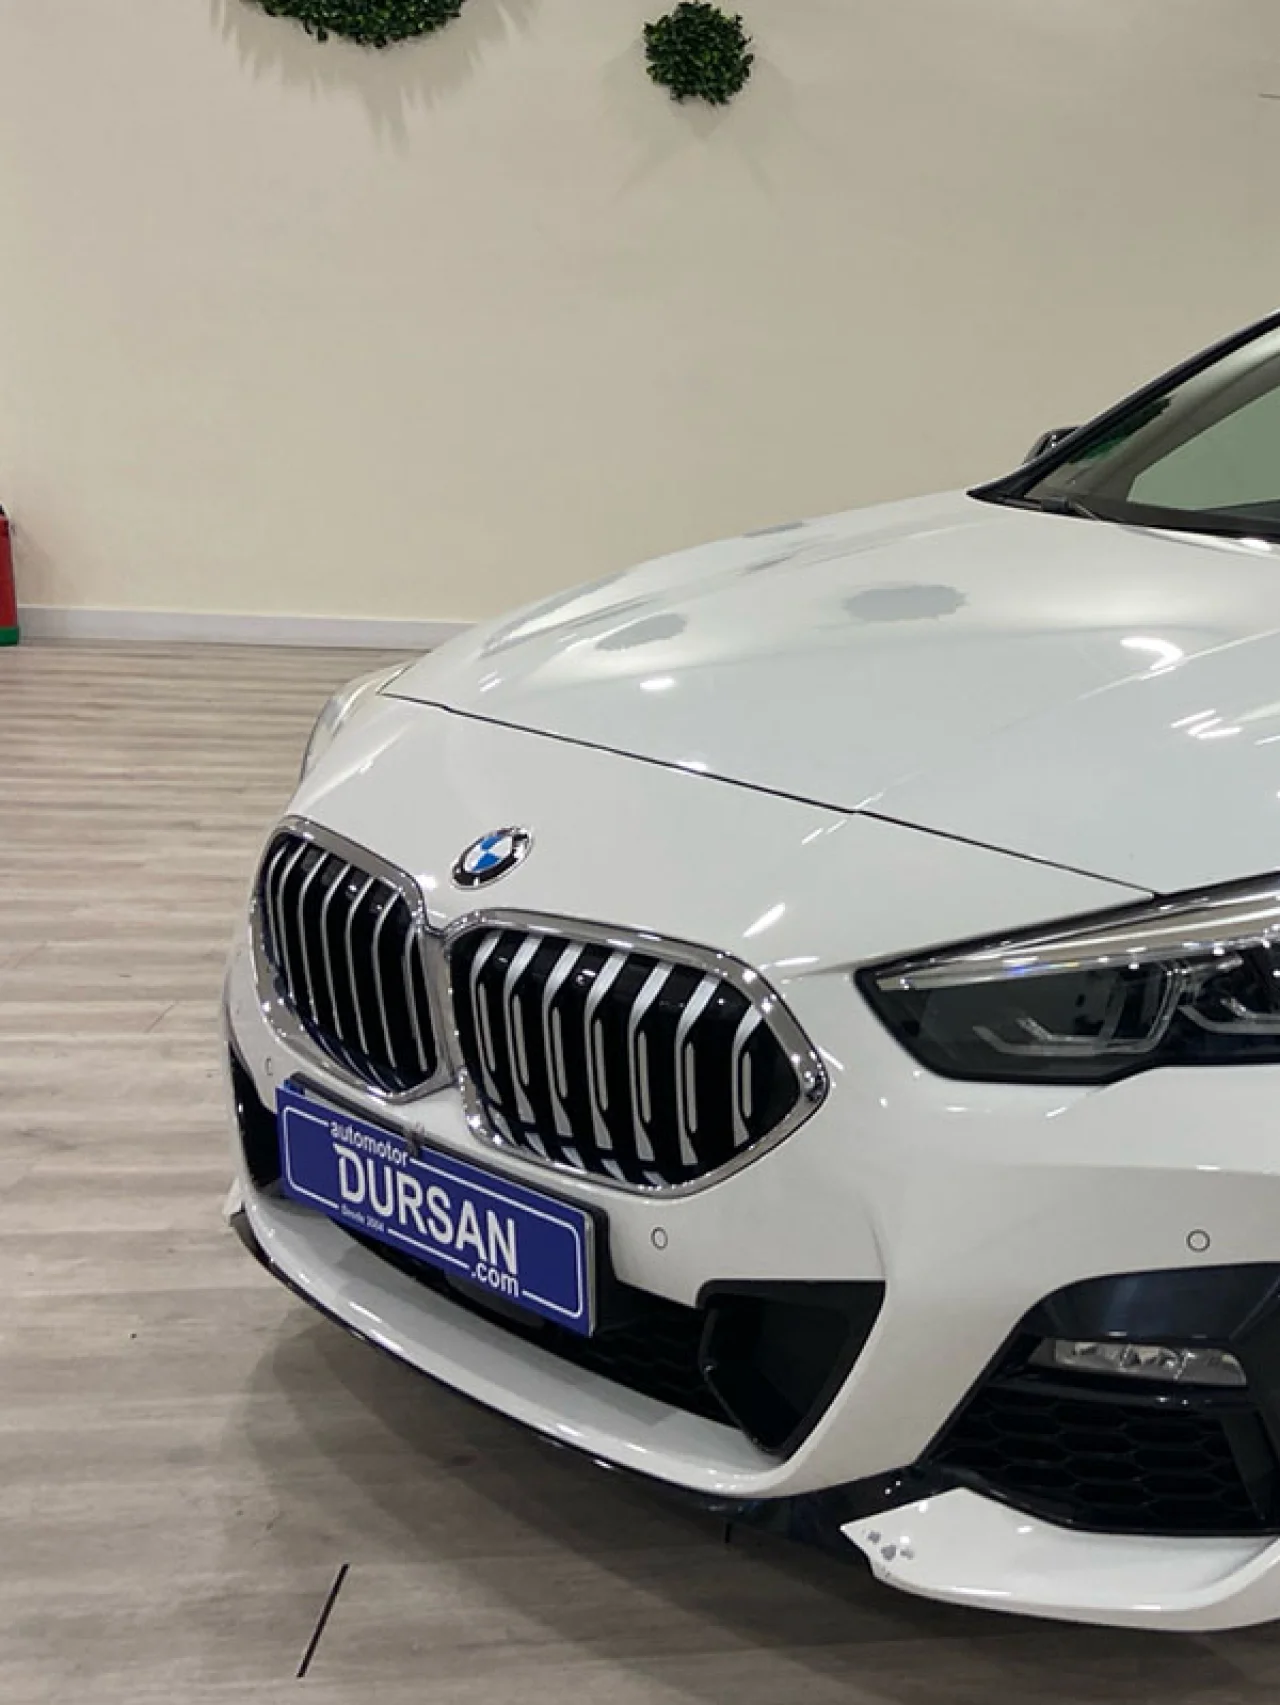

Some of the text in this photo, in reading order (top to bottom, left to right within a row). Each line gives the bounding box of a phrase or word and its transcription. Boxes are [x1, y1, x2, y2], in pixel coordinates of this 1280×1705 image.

[329, 1121, 409, 1168] automotor
[333, 1144, 518, 1274] DURSAN
[470, 1262, 519, 1298] .com
